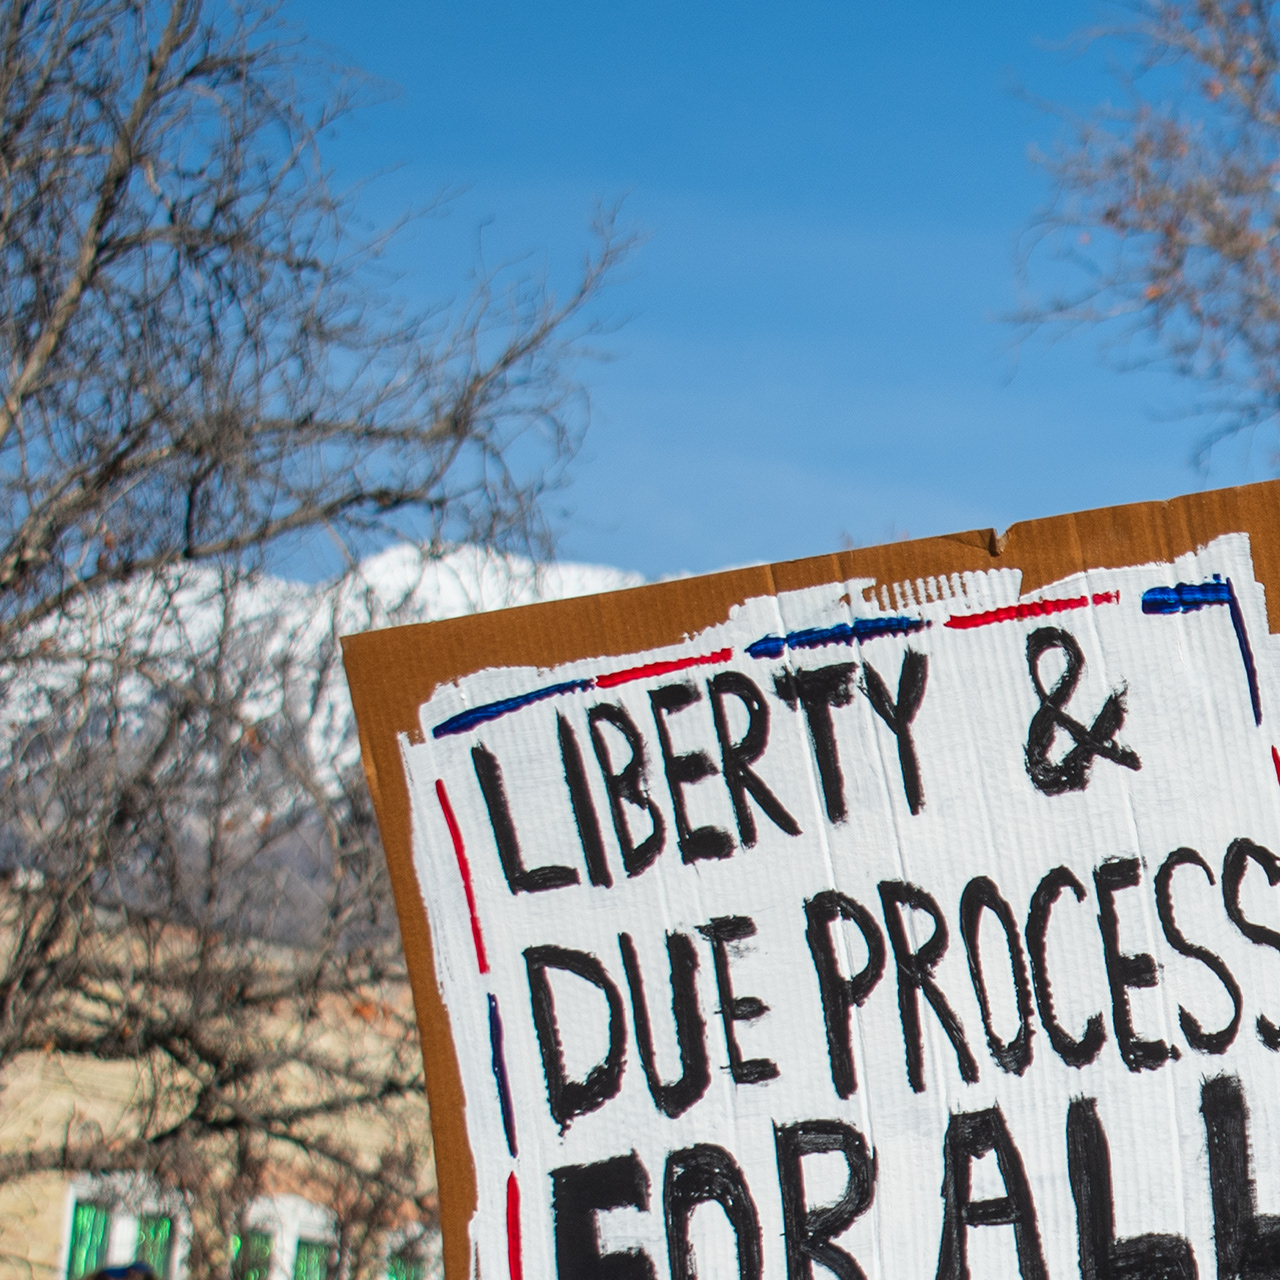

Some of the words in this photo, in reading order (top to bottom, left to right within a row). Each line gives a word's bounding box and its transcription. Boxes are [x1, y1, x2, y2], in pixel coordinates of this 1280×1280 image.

[471, 648, 928, 895] LIBERTY
[1023, 626, 1142, 796] &
[522, 915, 780, 1137] DUE
